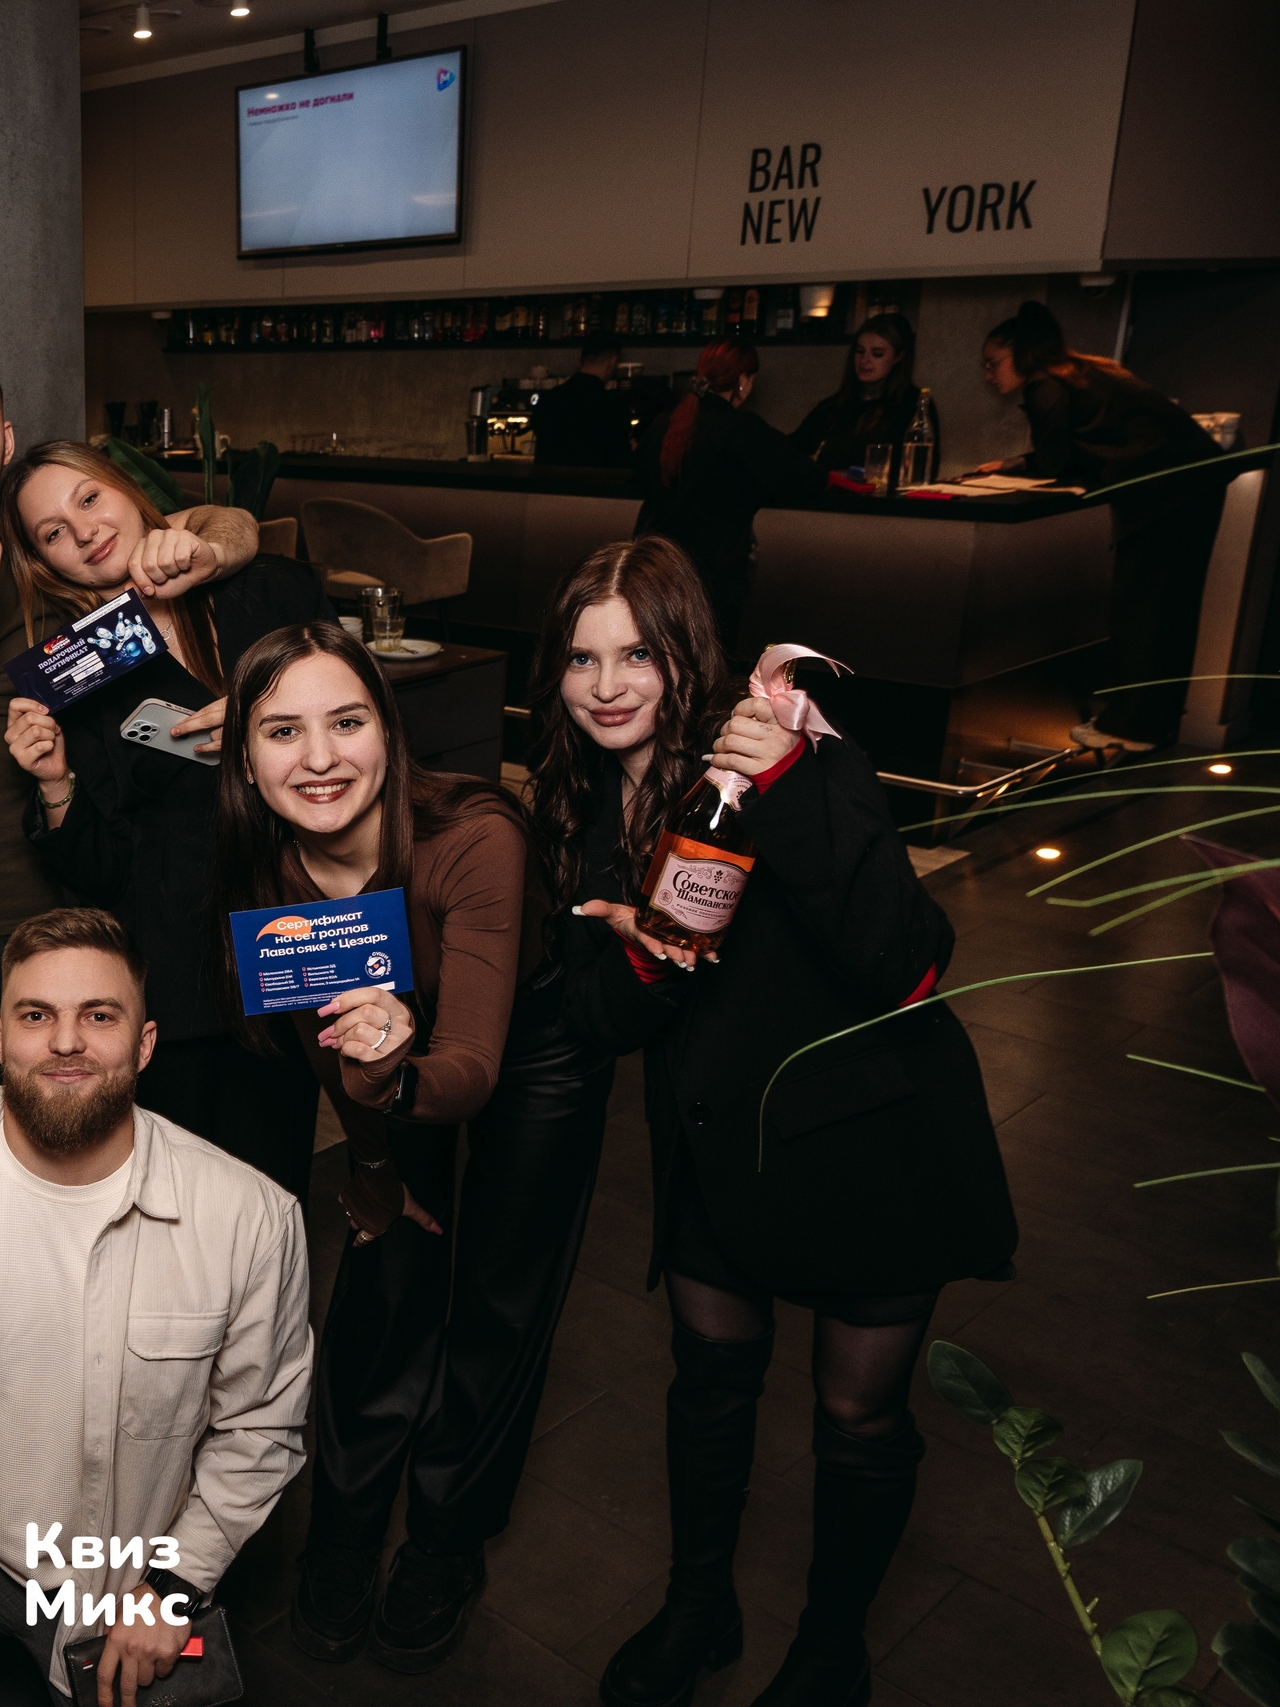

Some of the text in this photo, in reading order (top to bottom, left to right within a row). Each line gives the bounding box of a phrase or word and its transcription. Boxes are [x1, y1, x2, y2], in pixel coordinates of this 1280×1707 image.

[246, 92, 355, 118] Немножко не догнали
[748, 142, 822, 193] BAR
[740, 179, 1037, 246] NEW YORK
[37, 637, 86, 670] ПОДАРОЧНЫЙ
[44, 645, 89, 674] СЕРТИФИКАТ
[672, 870, 741, 901] Советское
[676, 888, 734, 910] Шампанское
[275, 923, 370, 944] на сет роллов
[276, 911, 363, 931] Сертификат
[259, 933, 388, 959] Лава сяке + Цезарь
